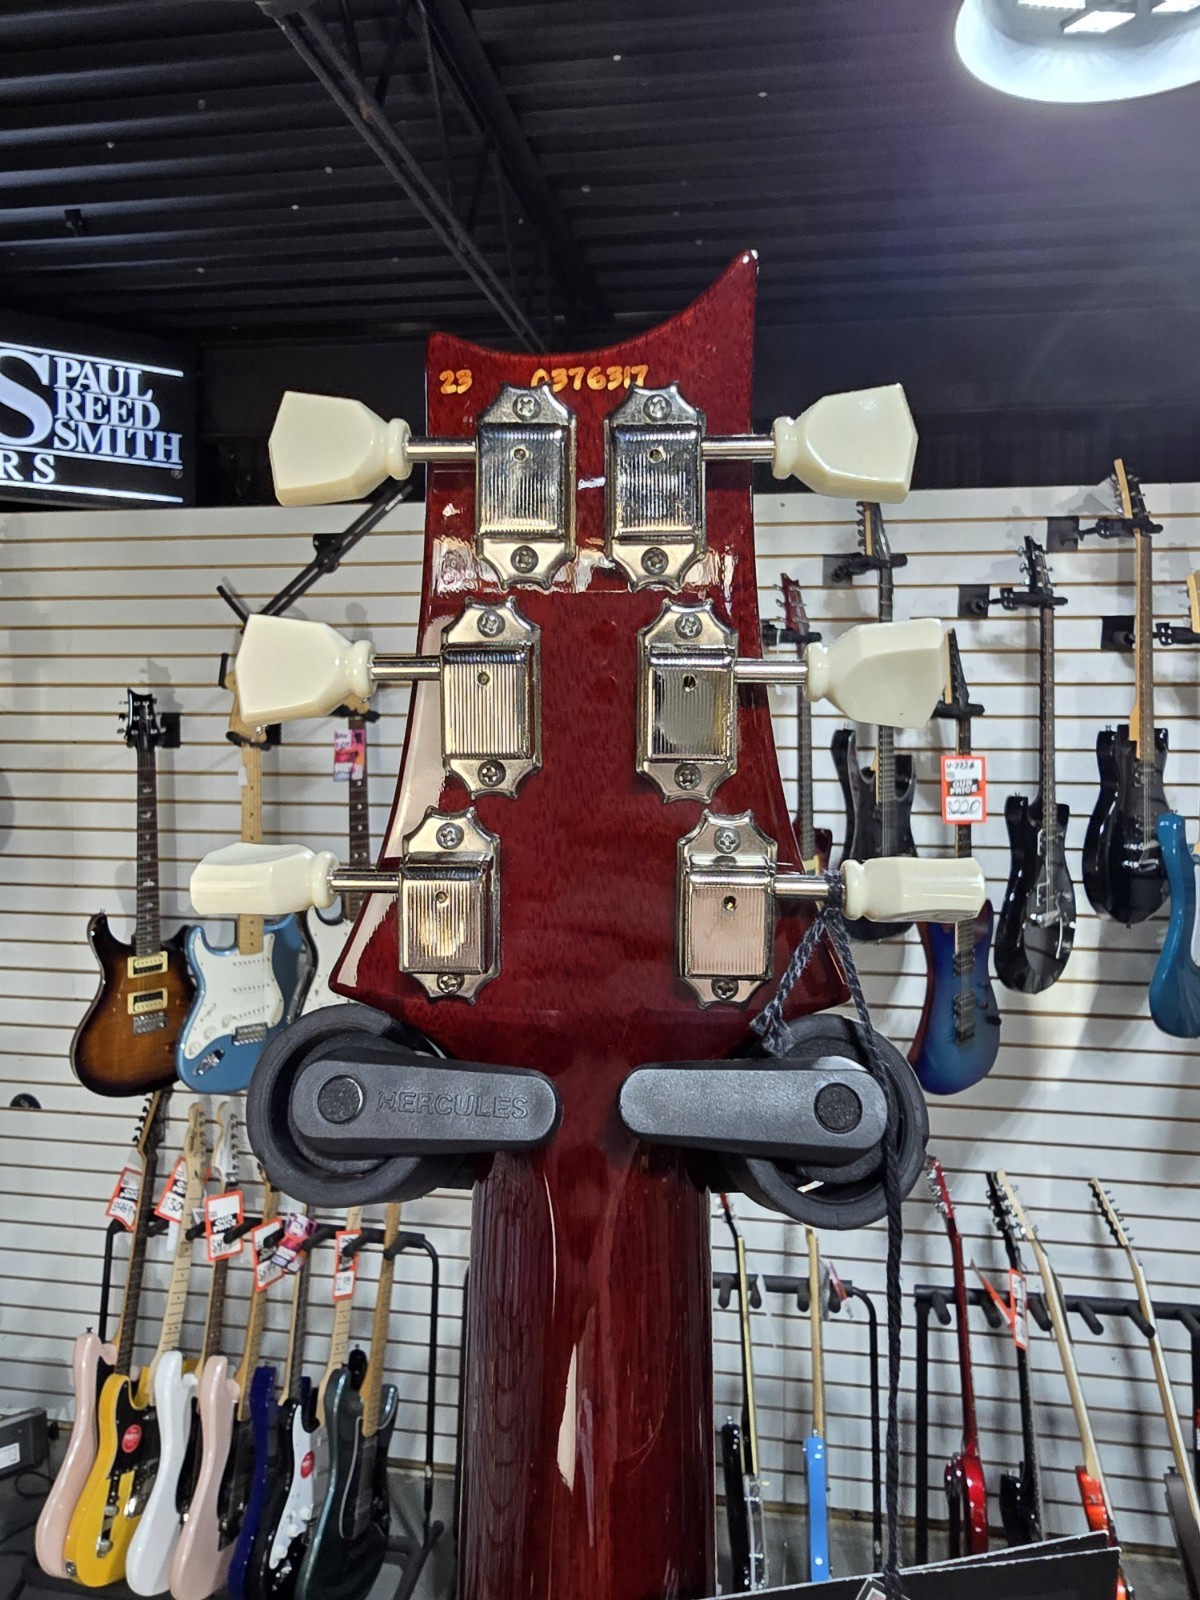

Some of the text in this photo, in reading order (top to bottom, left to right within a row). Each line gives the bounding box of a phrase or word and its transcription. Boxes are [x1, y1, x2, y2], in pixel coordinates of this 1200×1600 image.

[54, 356, 154, 401] PAUL
[439, 369, 473, 394] 23
[54, 388, 161, 430] REED
[53, 419, 183, 464] SMITH
[376, 1091, 529, 1119] HERCULES
